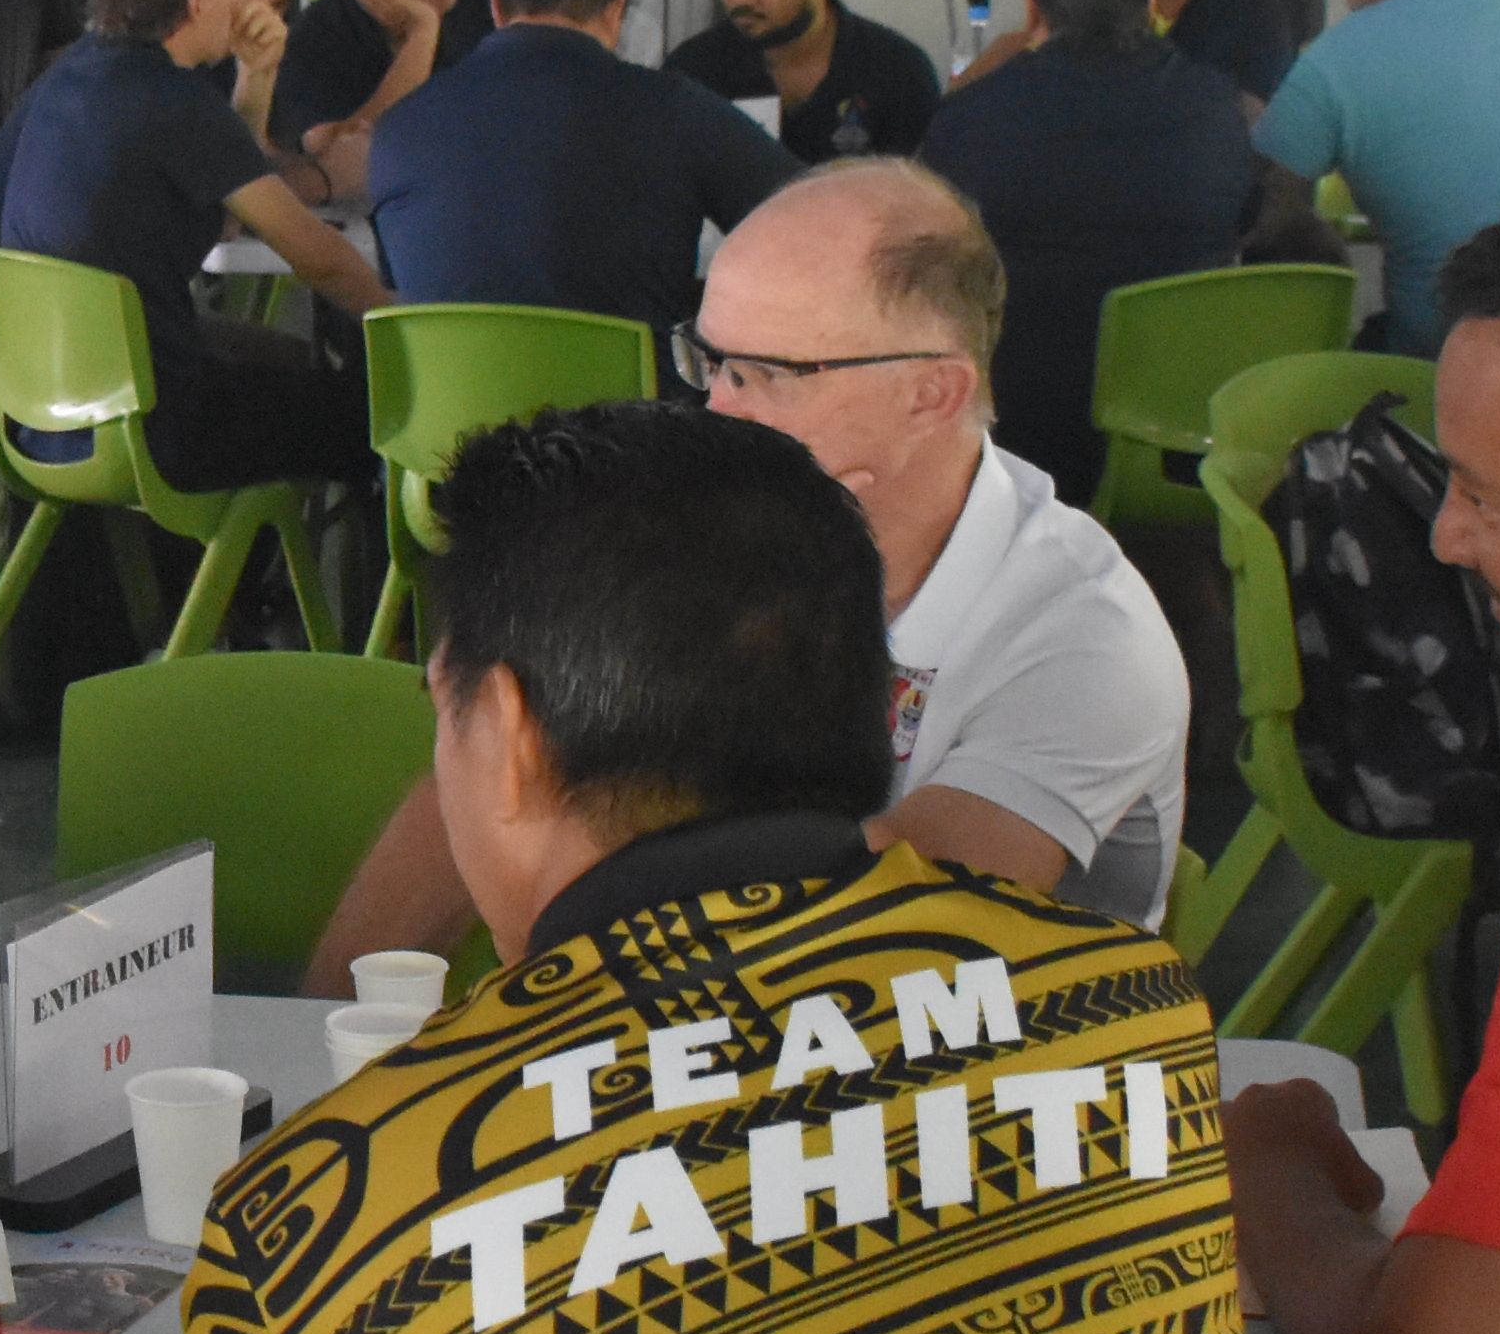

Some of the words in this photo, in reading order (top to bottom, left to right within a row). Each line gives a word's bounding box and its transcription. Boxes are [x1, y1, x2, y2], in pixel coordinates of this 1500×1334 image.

[31, 922, 196, 1026] ENTRAINEUR
[103, 1033, 132, 1072] 10
[522, 956, 1024, 1146] TEAM
[429, 1058, 1171, 1334] TAHITI
